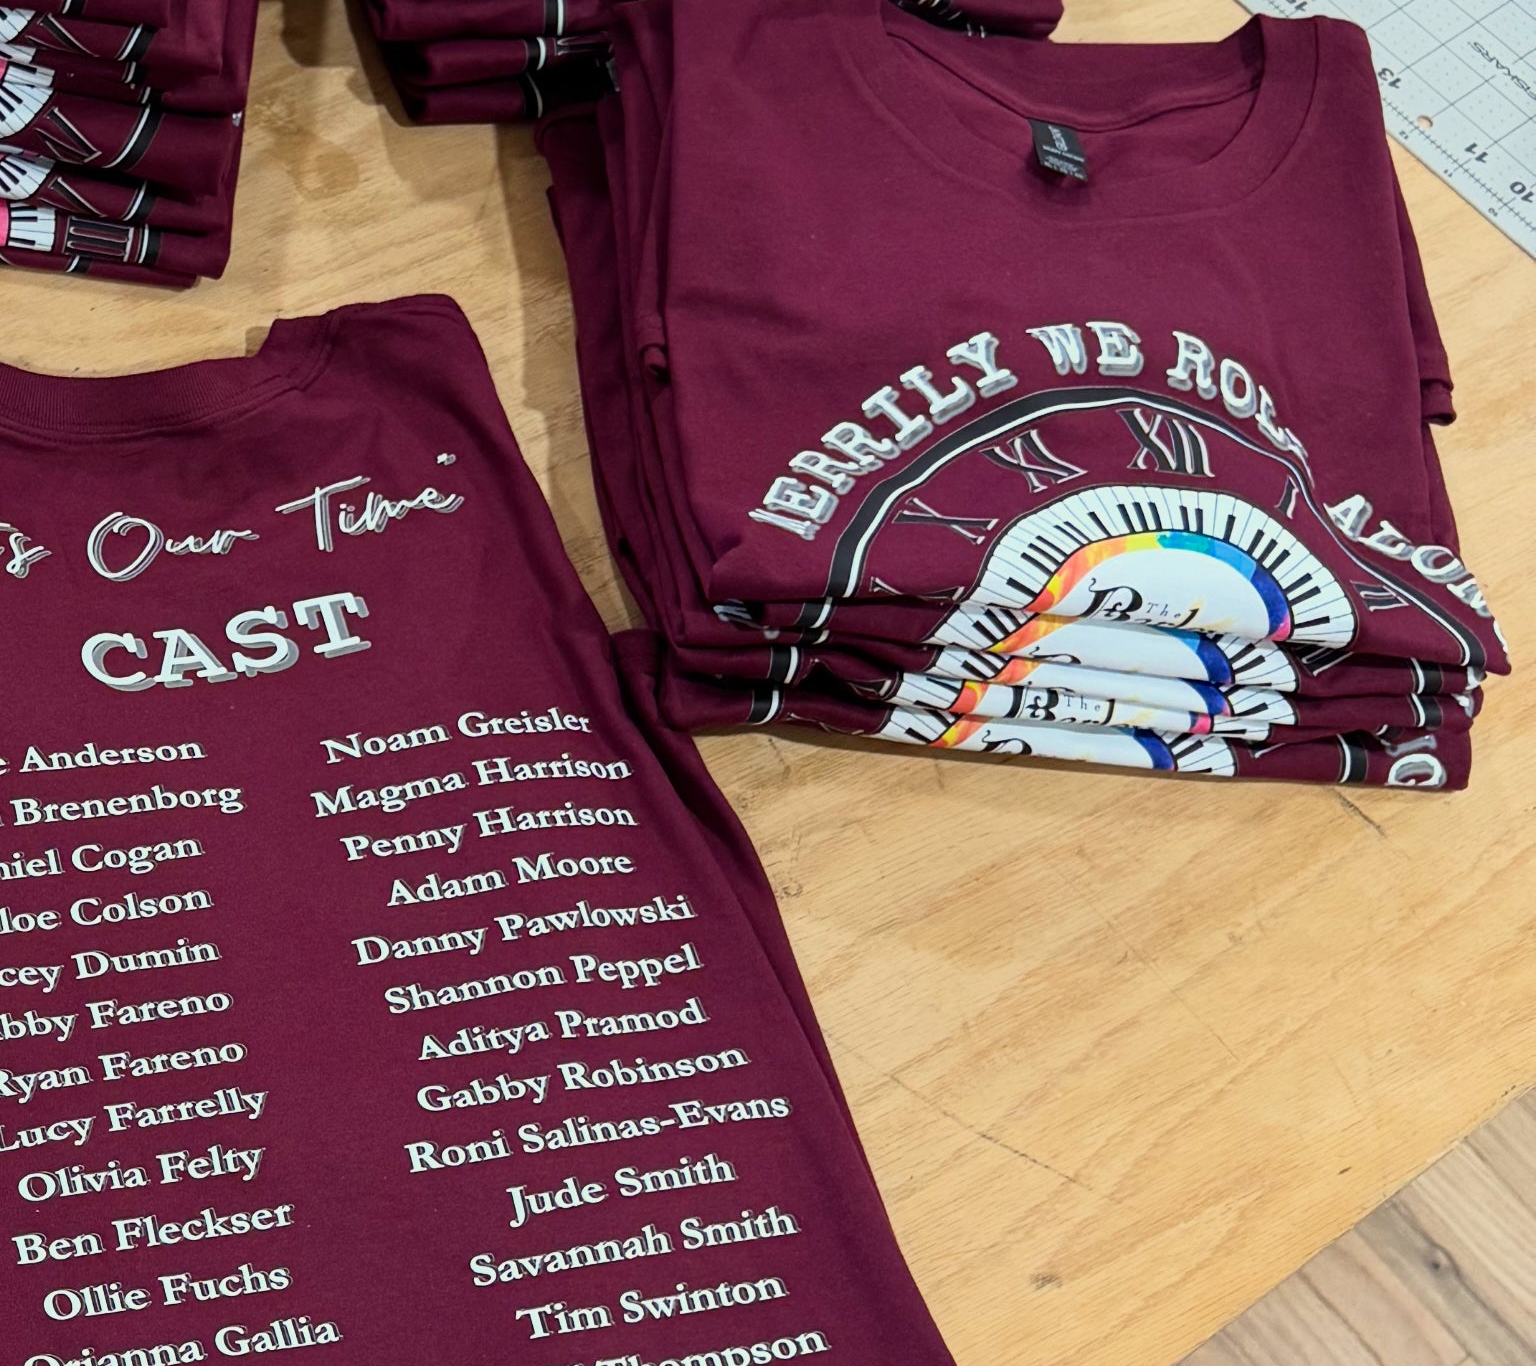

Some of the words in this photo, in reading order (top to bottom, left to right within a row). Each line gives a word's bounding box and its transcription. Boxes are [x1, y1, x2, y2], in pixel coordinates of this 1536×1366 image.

[1377, 67, 1402, 89] 13
[1464, 142, 1489, 164] 11
[1509, 181, 1536, 204] 10
[1026, 321, 1144, 376] WE
[1323, 493, 1504, 645] ALON
[87, 511, 258, 581] Our
[81, 592, 372, 692] CAST
[19, 742, 206, 773] Anderson
[320, 723, 451, 764] Noam
[457, 706, 592, 737] Greisler
[11, 784, 245, 827] Brenenborg
[310, 771, 467, 817] Magma
[472, 753, 632, 786] Harrison
[71, 838, 204, 874] Cogan
[340, 822, 467, 861] Penny
[473, 802, 639, 837] Harrison
[70, 889, 214, 927] Colson
[386, 869, 508, 906] Adam
[512, 853, 636, 885] Moore
[71, 939, 222, 979] Dumin
[351, 926, 488, 966] Danny
[494, 894, 697, 942] Pawlowski
[384, 961, 565, 1014] Shannon
[569, 943, 704, 989] Peppel
[86, 992, 234, 1029] Fareno
[418, 1019, 551, 1061] Aditya
[555, 997, 711, 1039] Pramod
[98, 1042, 248, 1081] Fareno
[416, 1073, 551, 1112] Gabby
[557, 1048, 750, 1090] Robinson
[104, 1088, 269, 1131] Farrelly
[404, 1130, 513, 1173] Roni
[518, 1096, 793, 1153] Salinas-Evans
[17, 1160, 150, 1202] Olivia
[156, 1145, 266, 1184] Felty
[506, 1176, 609, 1228] Jude
[614, 1153, 738, 1197] Smith
[11, 1231, 105, 1265] Ben
[111, 1204, 295, 1251] Fleckser
[469, 1224, 674, 1287] Savannah
[679, 1206, 801, 1250] Smith
[42, 1283, 152, 1321] Ollie
[157, 1263, 293, 1306] Fuchs
[515, 1302, 614, 1339] Tim
[619, 1277, 789, 1324] Swinton
[214, 1316, 343, 1356] Gallia
